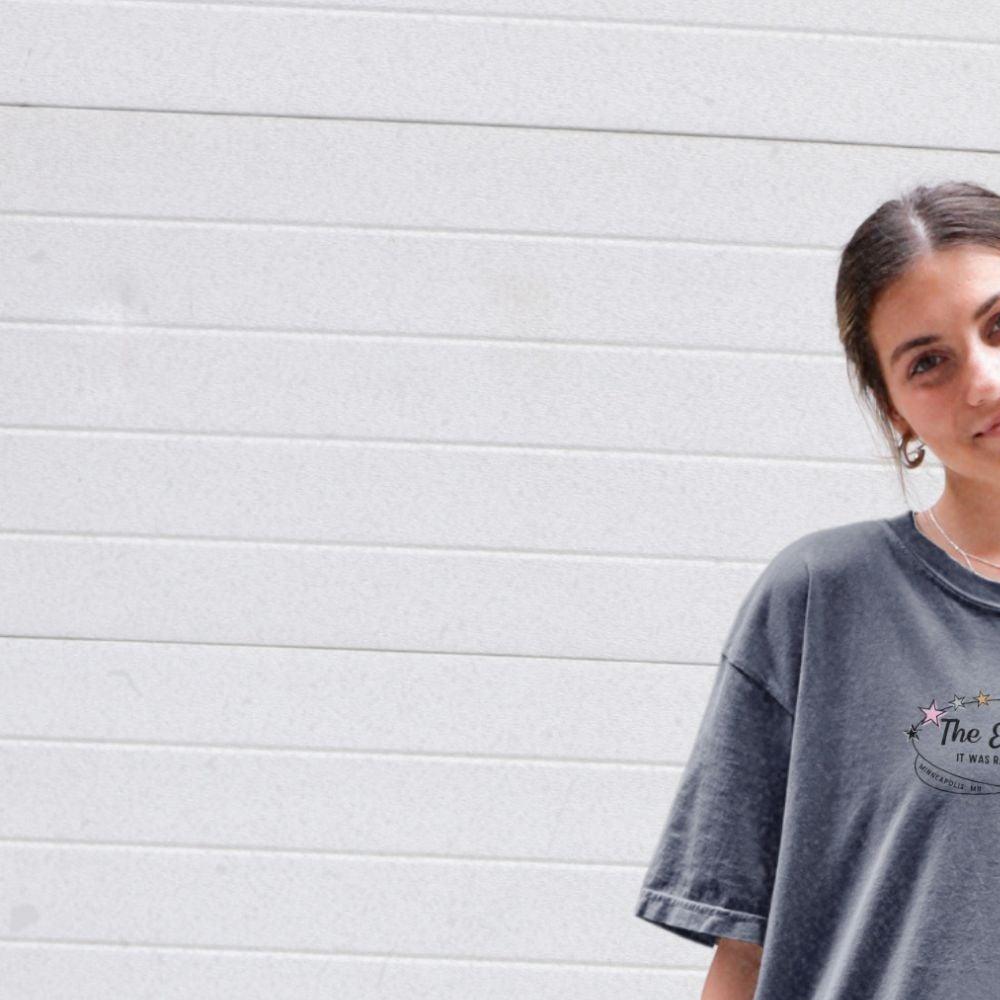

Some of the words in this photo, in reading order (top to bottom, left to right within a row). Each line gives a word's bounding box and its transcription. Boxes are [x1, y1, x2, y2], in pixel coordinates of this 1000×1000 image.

[941, 718, 981, 745] The
[956, 752, 965, 762] IT
[969, 754, 990, 765] WAS
